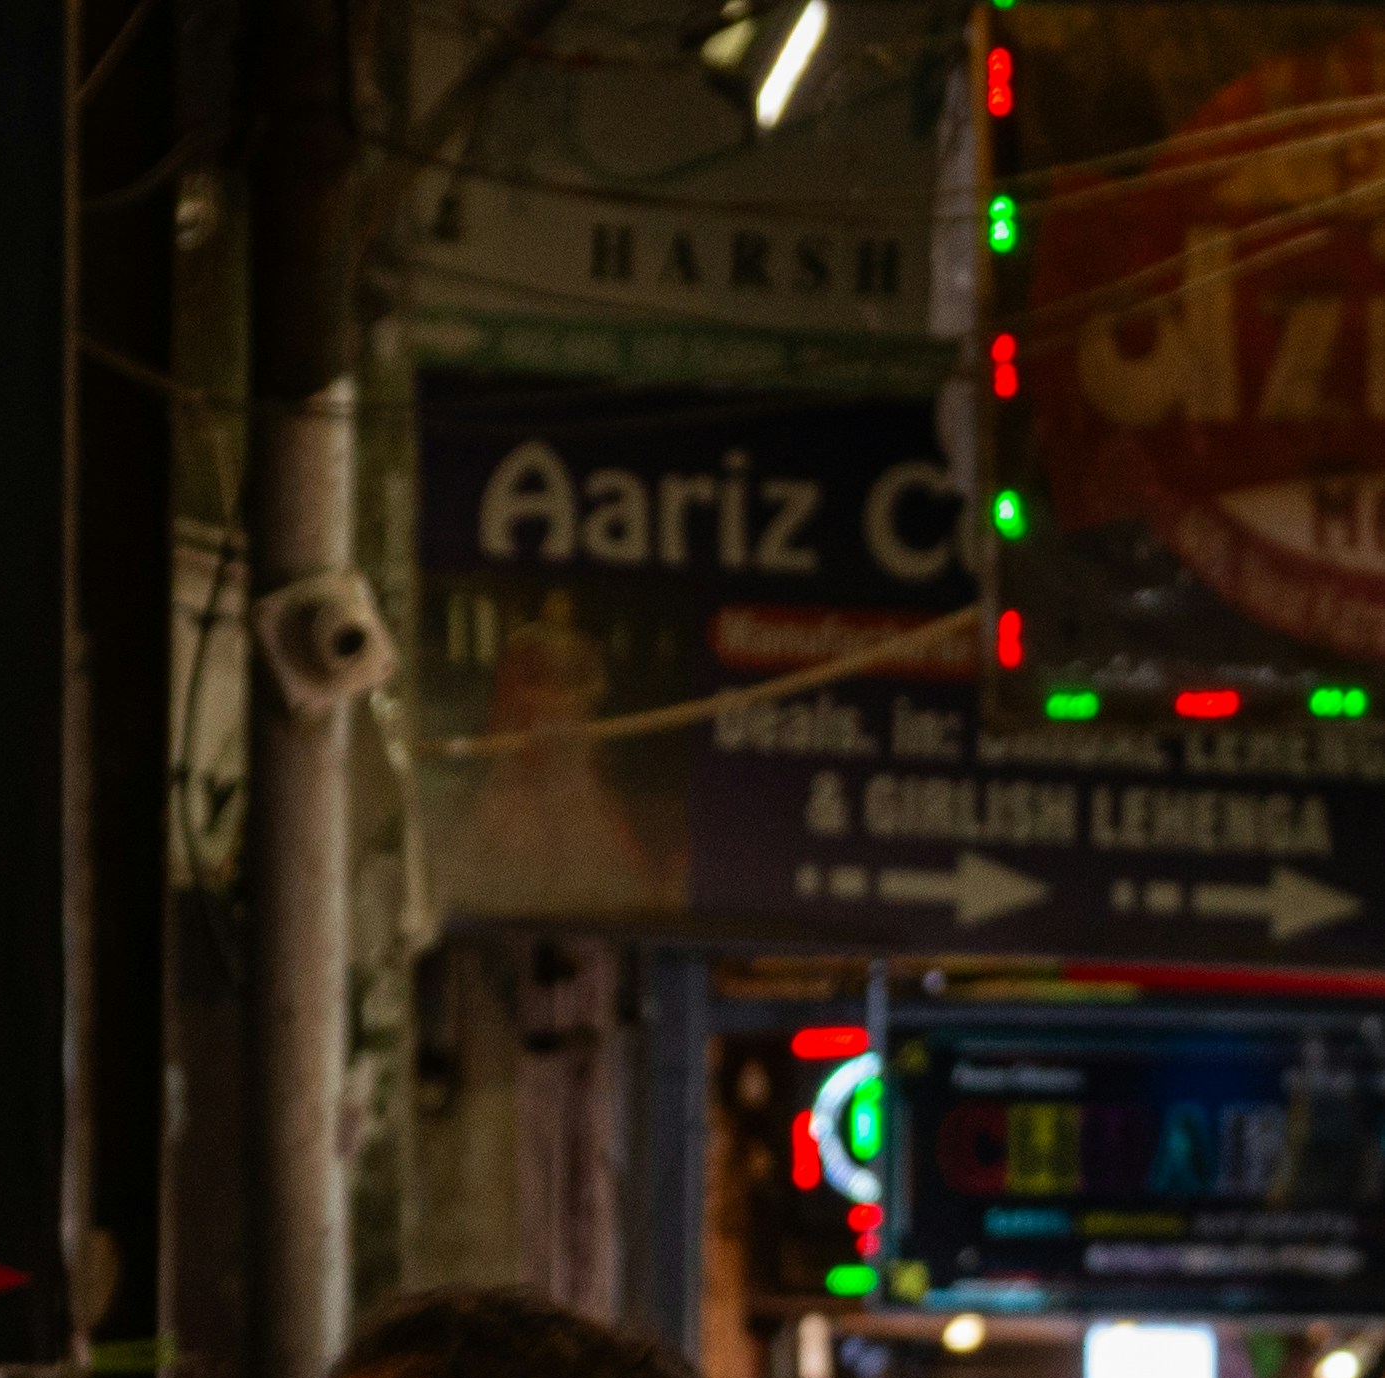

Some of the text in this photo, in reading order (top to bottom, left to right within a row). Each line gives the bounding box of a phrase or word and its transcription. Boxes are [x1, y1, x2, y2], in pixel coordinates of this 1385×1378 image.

[590, 222, 901, 296] HARSH
[478, 439, 824, 572] Aariz
[864, 772, 1078, 848] GIRLISH
[1089, 784, 1334, 860] LEHENGA
